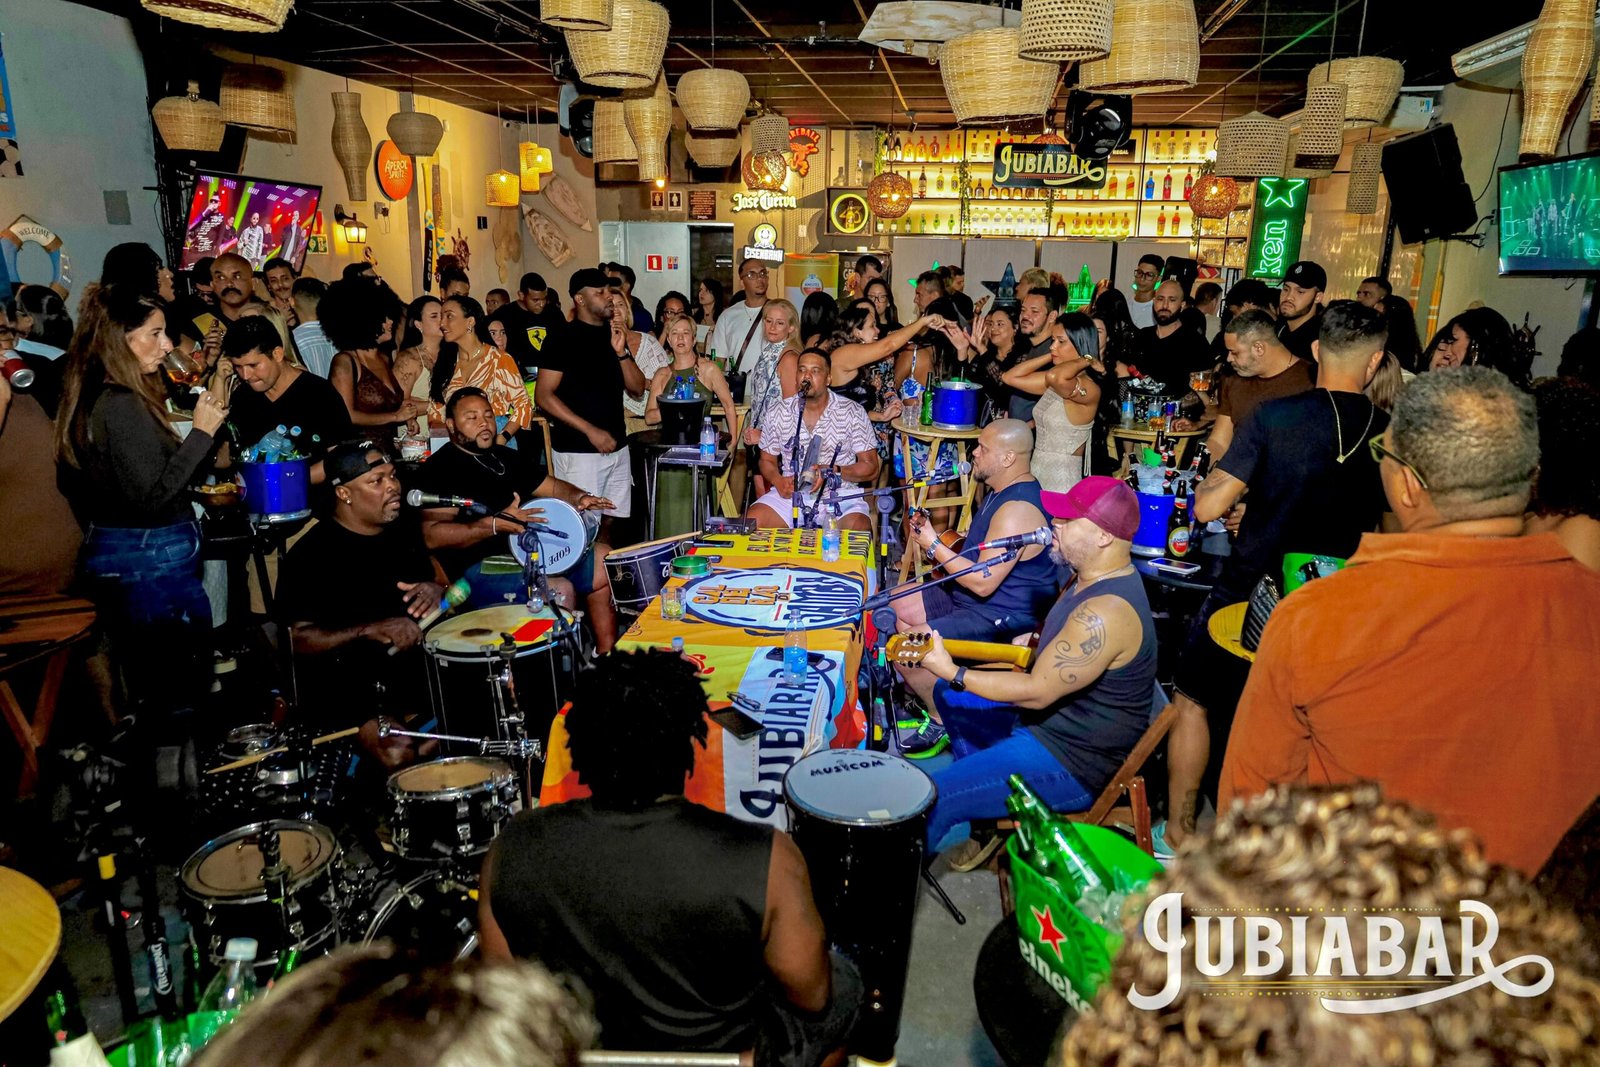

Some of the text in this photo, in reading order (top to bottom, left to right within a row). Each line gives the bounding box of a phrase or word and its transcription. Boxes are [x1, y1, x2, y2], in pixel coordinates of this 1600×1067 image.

[789, 127, 820, 143] IREBALL
[19, 227, 51, 238] WELCOME
[548, 545, 571, 567] GOPE
[1019, 937, 1094, 1013] eineke
